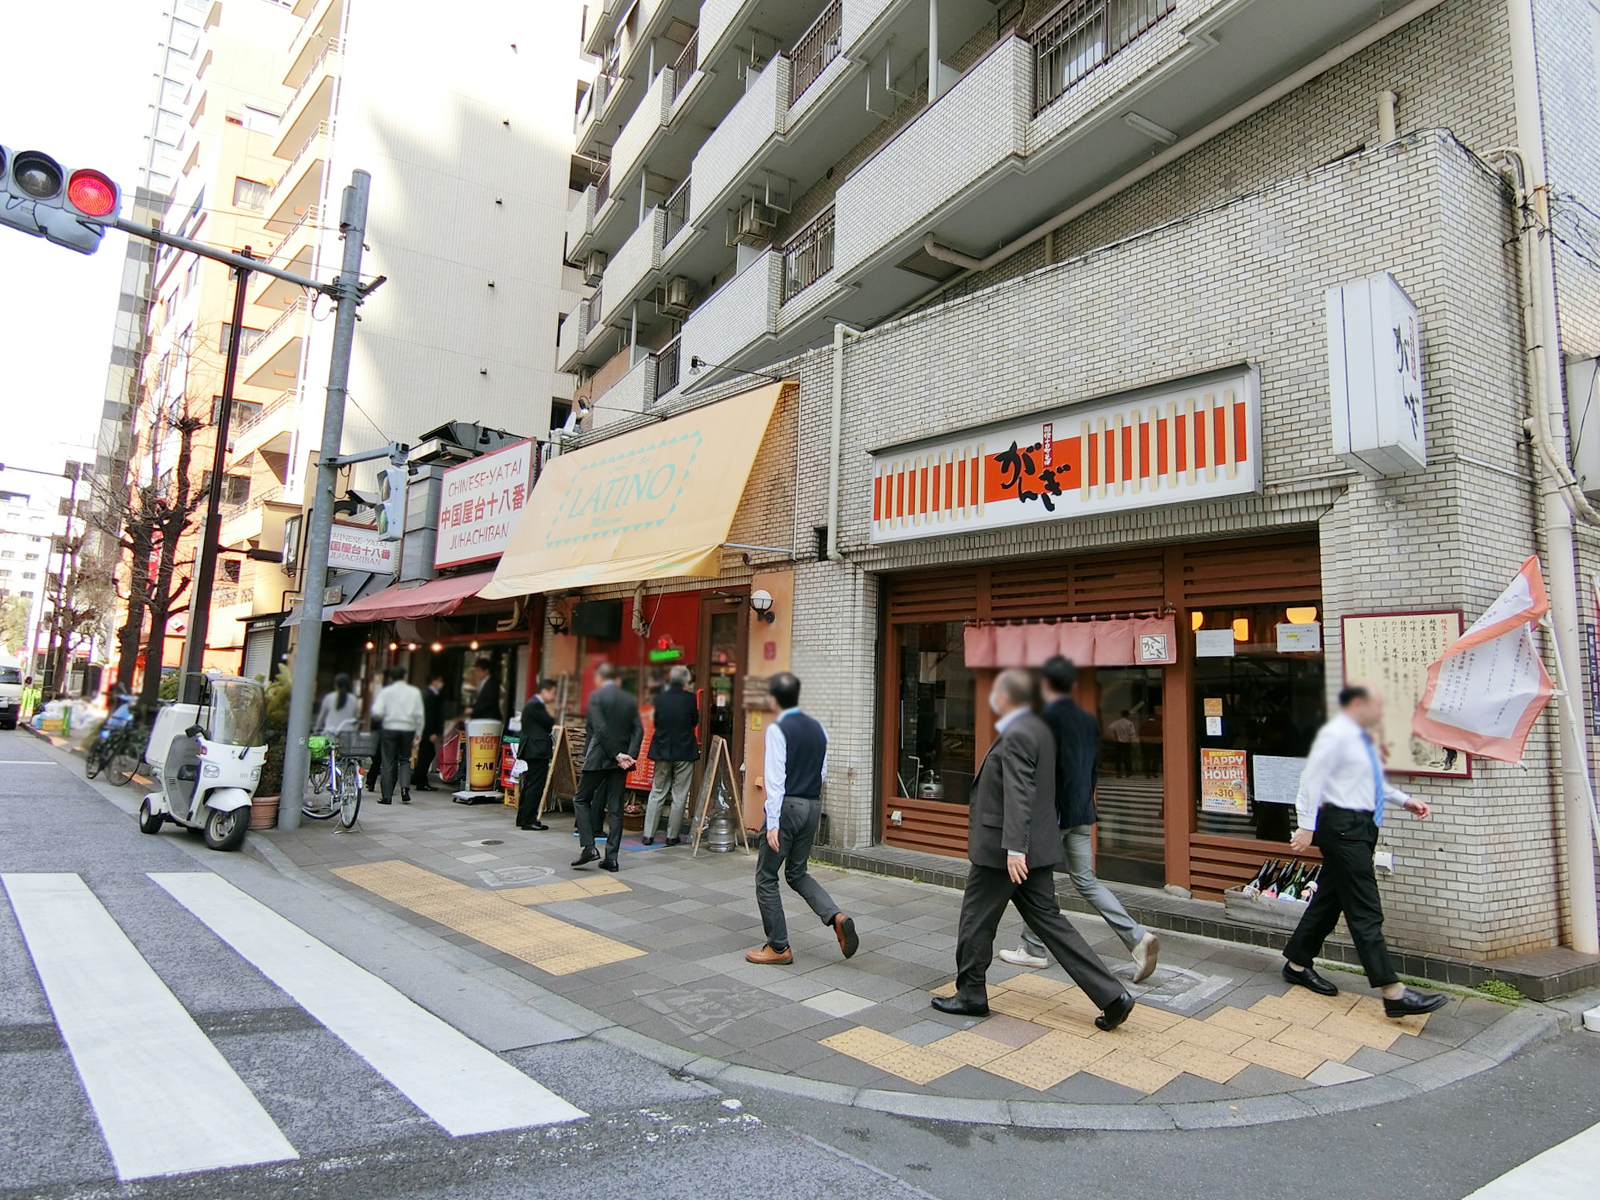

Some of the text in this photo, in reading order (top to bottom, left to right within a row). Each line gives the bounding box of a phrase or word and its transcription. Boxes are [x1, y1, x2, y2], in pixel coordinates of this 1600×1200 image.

[448, 458, 522, 498] CHINESE-YATAI
[567, 463, 676, 520] LATINO
[993, 440, 1071, 512] がんぎ
[441, 483, 526, 530] 中国屋台十八番
[449, 521, 510, 551] JUHACHIBAN
[1203, 755, 1244, 766] HAPPY
[1204, 769, 1244, 780] HOUR!!
